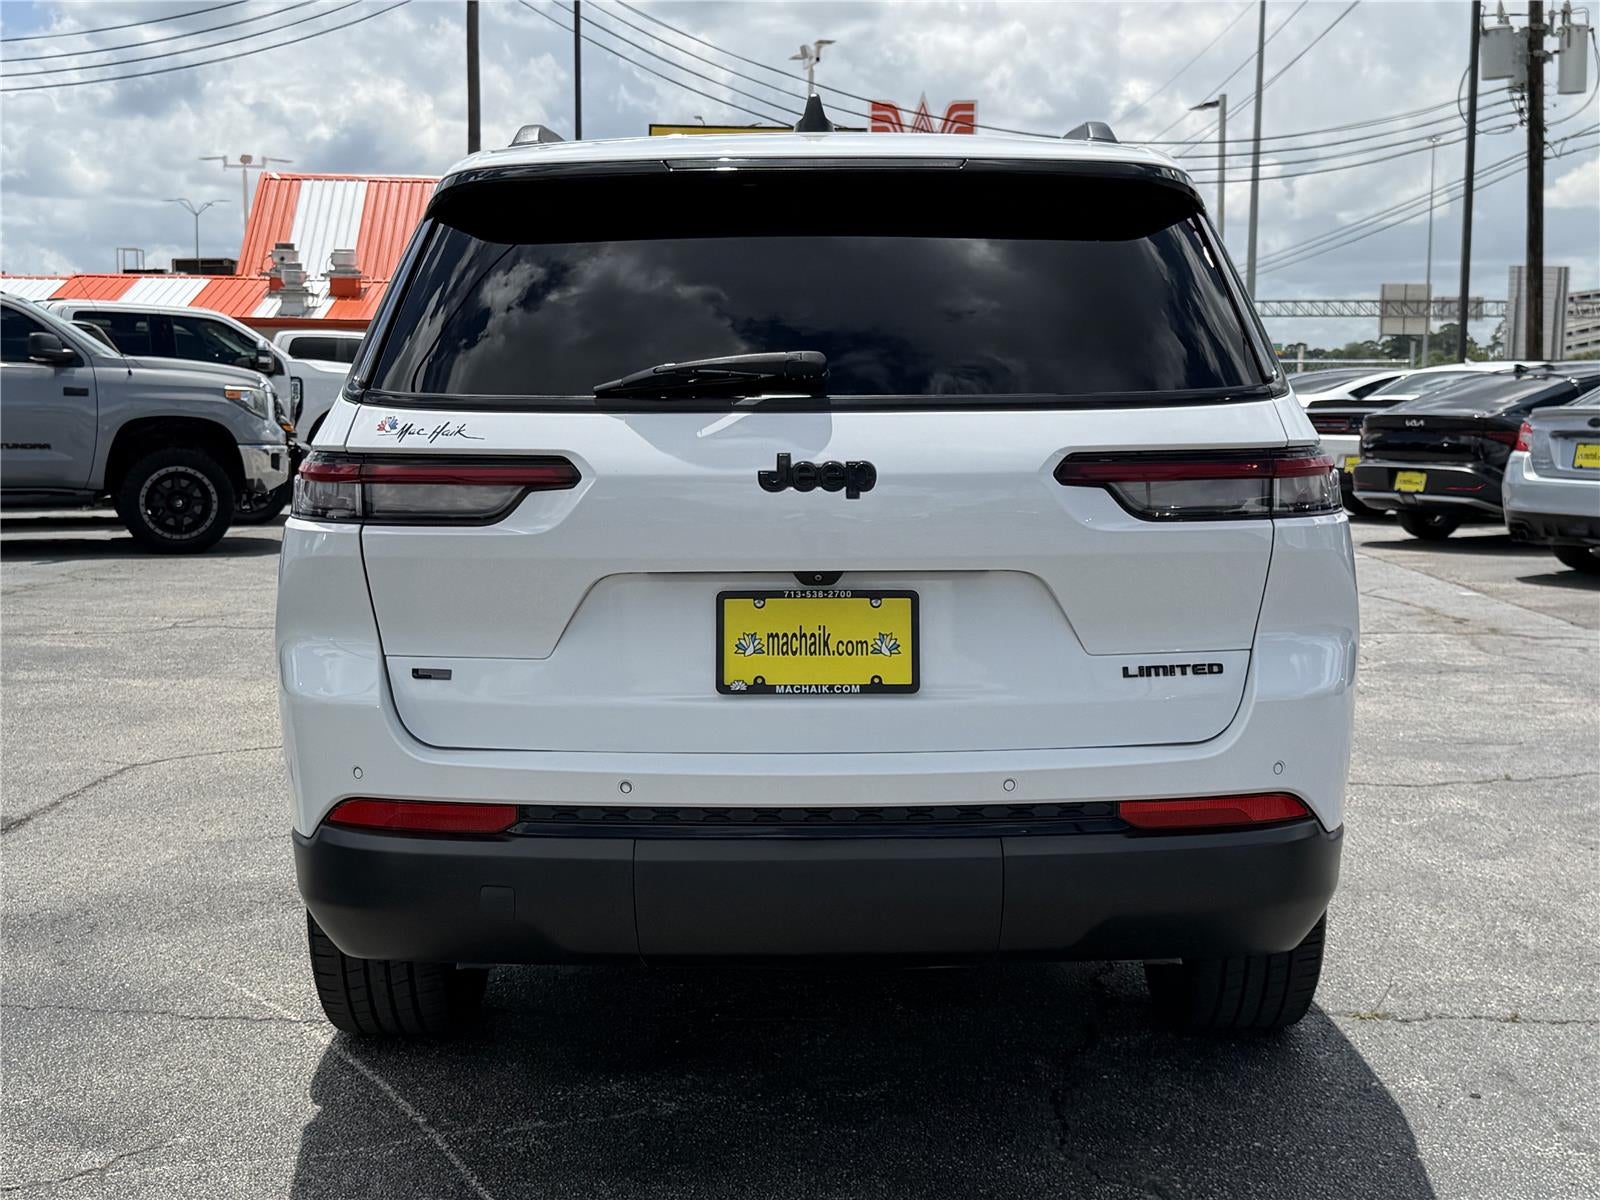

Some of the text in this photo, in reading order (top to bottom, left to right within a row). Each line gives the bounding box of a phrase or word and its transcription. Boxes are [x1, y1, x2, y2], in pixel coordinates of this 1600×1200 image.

[396, 421, 485, 444] Mac Haik
[758, 452, 877, 499] Jeep
[766, 625, 869, 656] machaik.com
[1122, 663, 1224, 678] LIMITED
[775, 685, 860, 694] MACHAIK.COM
